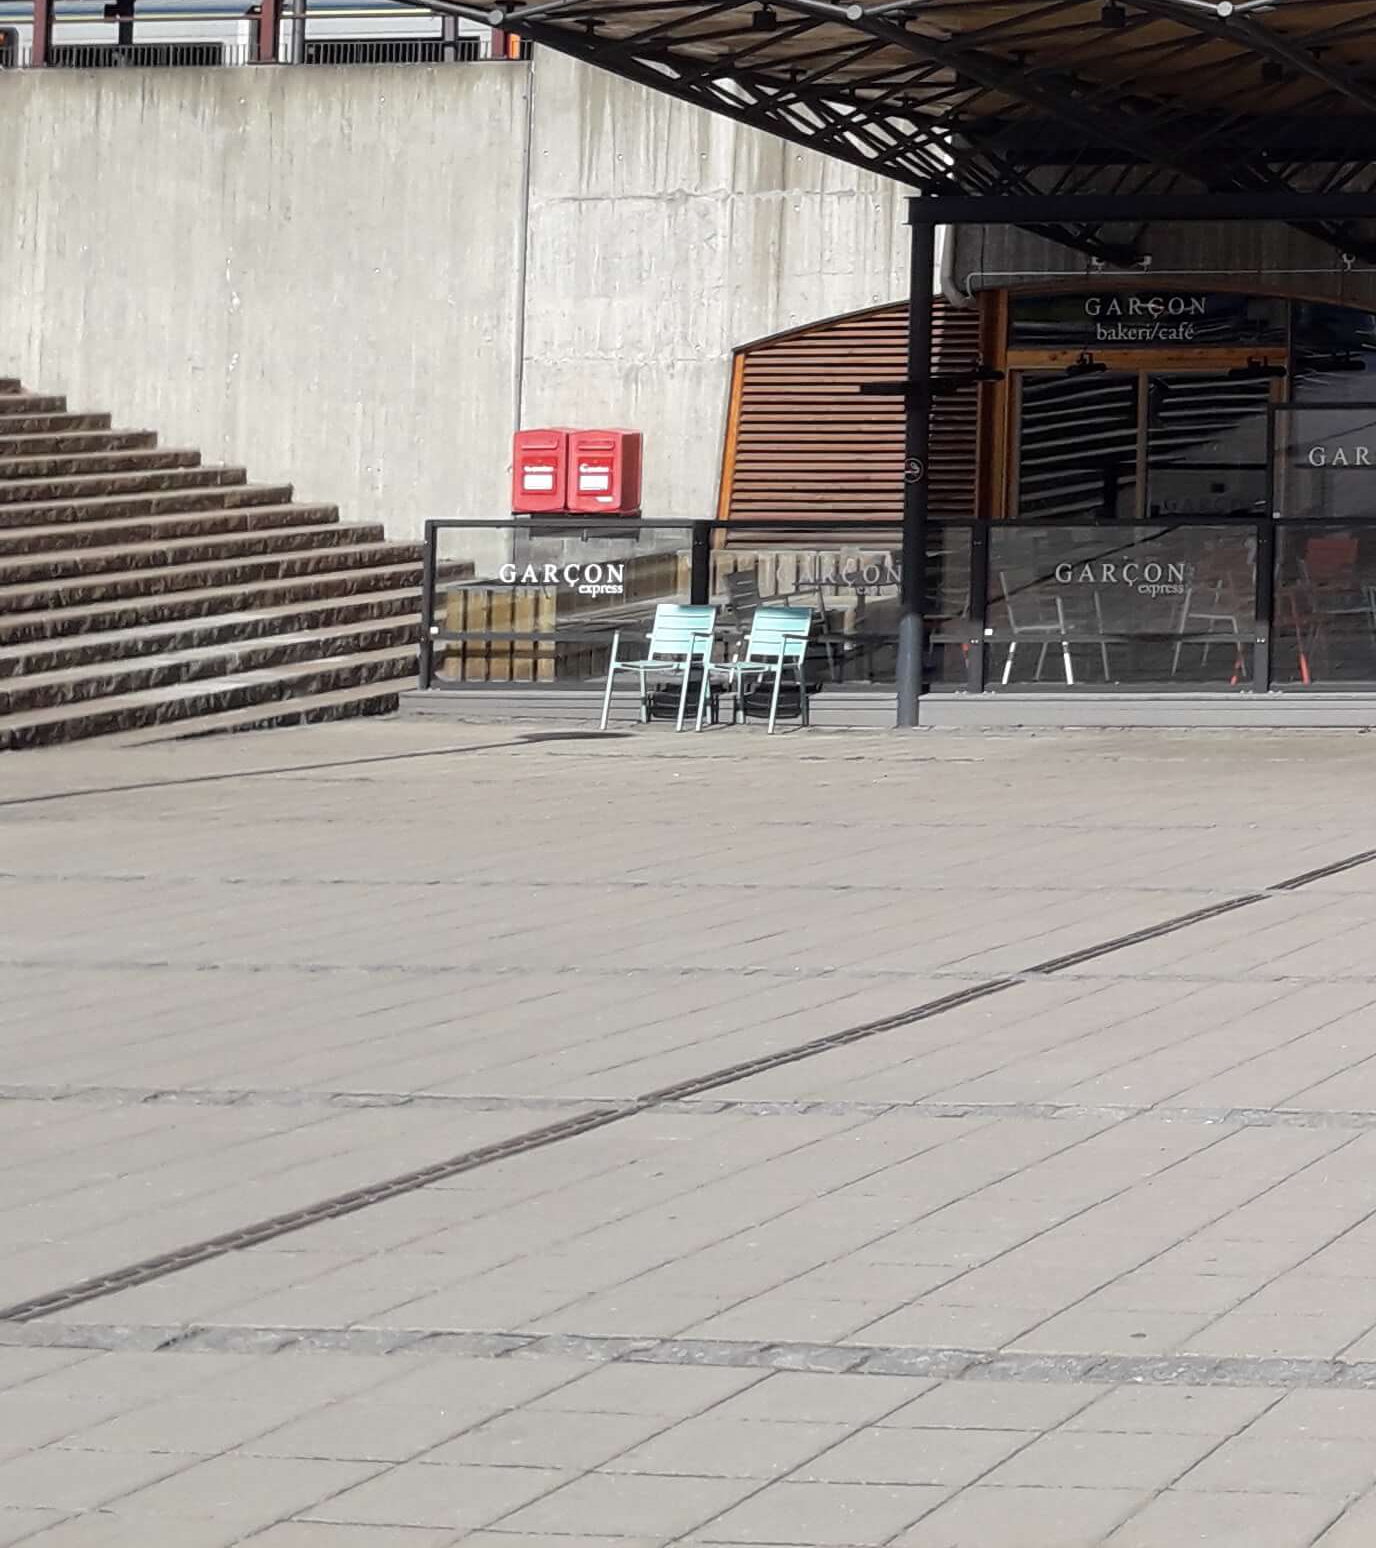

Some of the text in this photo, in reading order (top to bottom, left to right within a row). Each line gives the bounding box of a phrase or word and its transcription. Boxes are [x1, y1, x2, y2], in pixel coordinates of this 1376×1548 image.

[1084, 296, 1207, 319] GARÇON
[1096, 322, 1195, 341] bakeri/café
[499, 563, 624, 588] GARÇON
[1055, 563, 1185, 587] GARÇON
[578, 584, 623, 598] express
[1137, 583, 1185, 598] express
